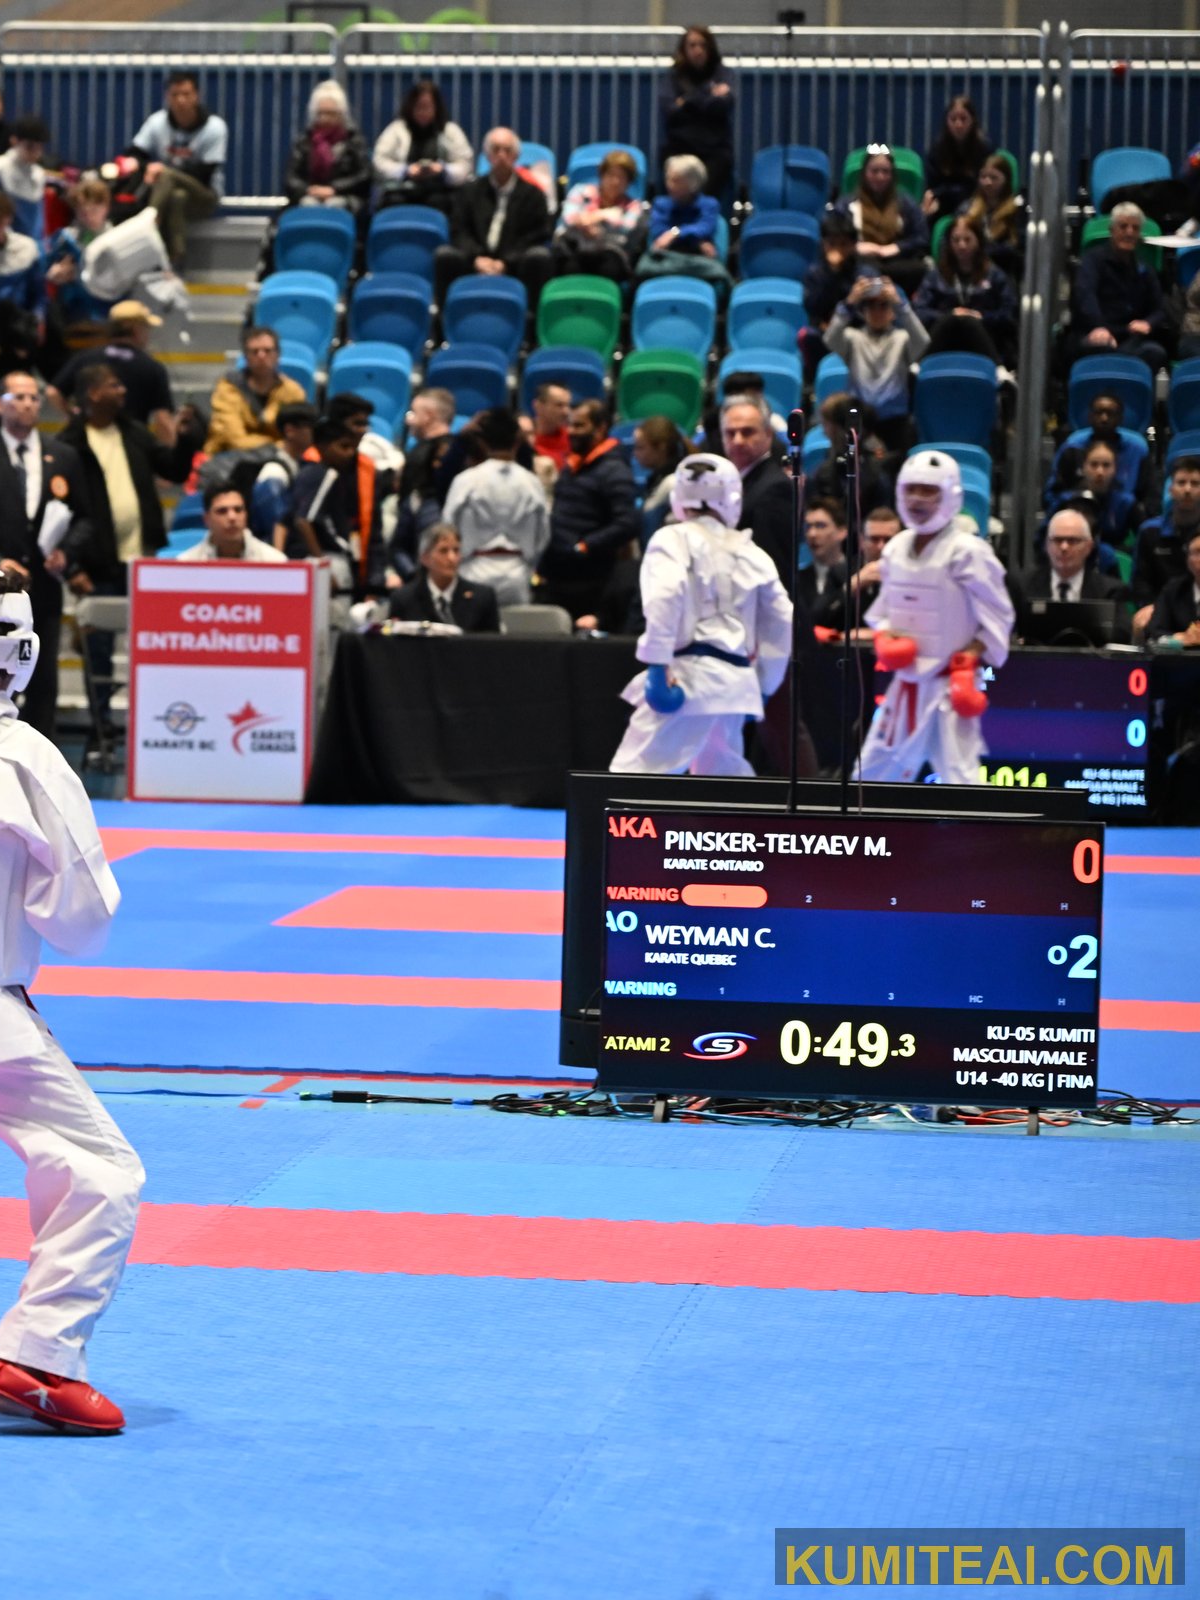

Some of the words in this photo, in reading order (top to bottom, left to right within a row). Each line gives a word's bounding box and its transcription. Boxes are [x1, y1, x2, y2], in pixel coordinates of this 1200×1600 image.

[180, 603, 262, 623] COACH
[1128, 668, 1147, 696] 0
[1126, 719, 1146, 747] 0
[142, 740, 194, 750] KARATE
[664, 830, 859, 855] PINSKER-TELYAEV
[864, 836, 891, 856] M.
[664, 858, 708, 870] KARATE
[709, 860, 764, 872] ONTARIO
[1073, 839, 1100, 884] 0
[805, 894, 812, 903] 2
[890, 897, 897, 905] 3
[971, 899, 986, 908] HC
[1060, 902, 1068, 910] H
[645, 925, 749, 947] WEYMAN
[755, 928, 776, 948] C.
[645, 952, 689, 964] KARATE
[690, 953, 736, 966] QUEBEC
[719, 987, 725, 995] 1
[803, 989, 810, 997] 2
[888, 992, 895, 1000] 3
[969, 995, 983, 1003] HC
[1058, 998, 1066, 1006] H
[987, 1026, 1035, 1041] KU-05
[603, 1036, 656, 1051] ATAMI
[659, 1038, 670, 1052] 2
[953, 1048, 1087, 1066] MASCULIN/MALE
[956, 1071, 987, 1085] U14
[991, 1072, 1018, 1087] -40
[1022, 1073, 1045, 1087] KG
